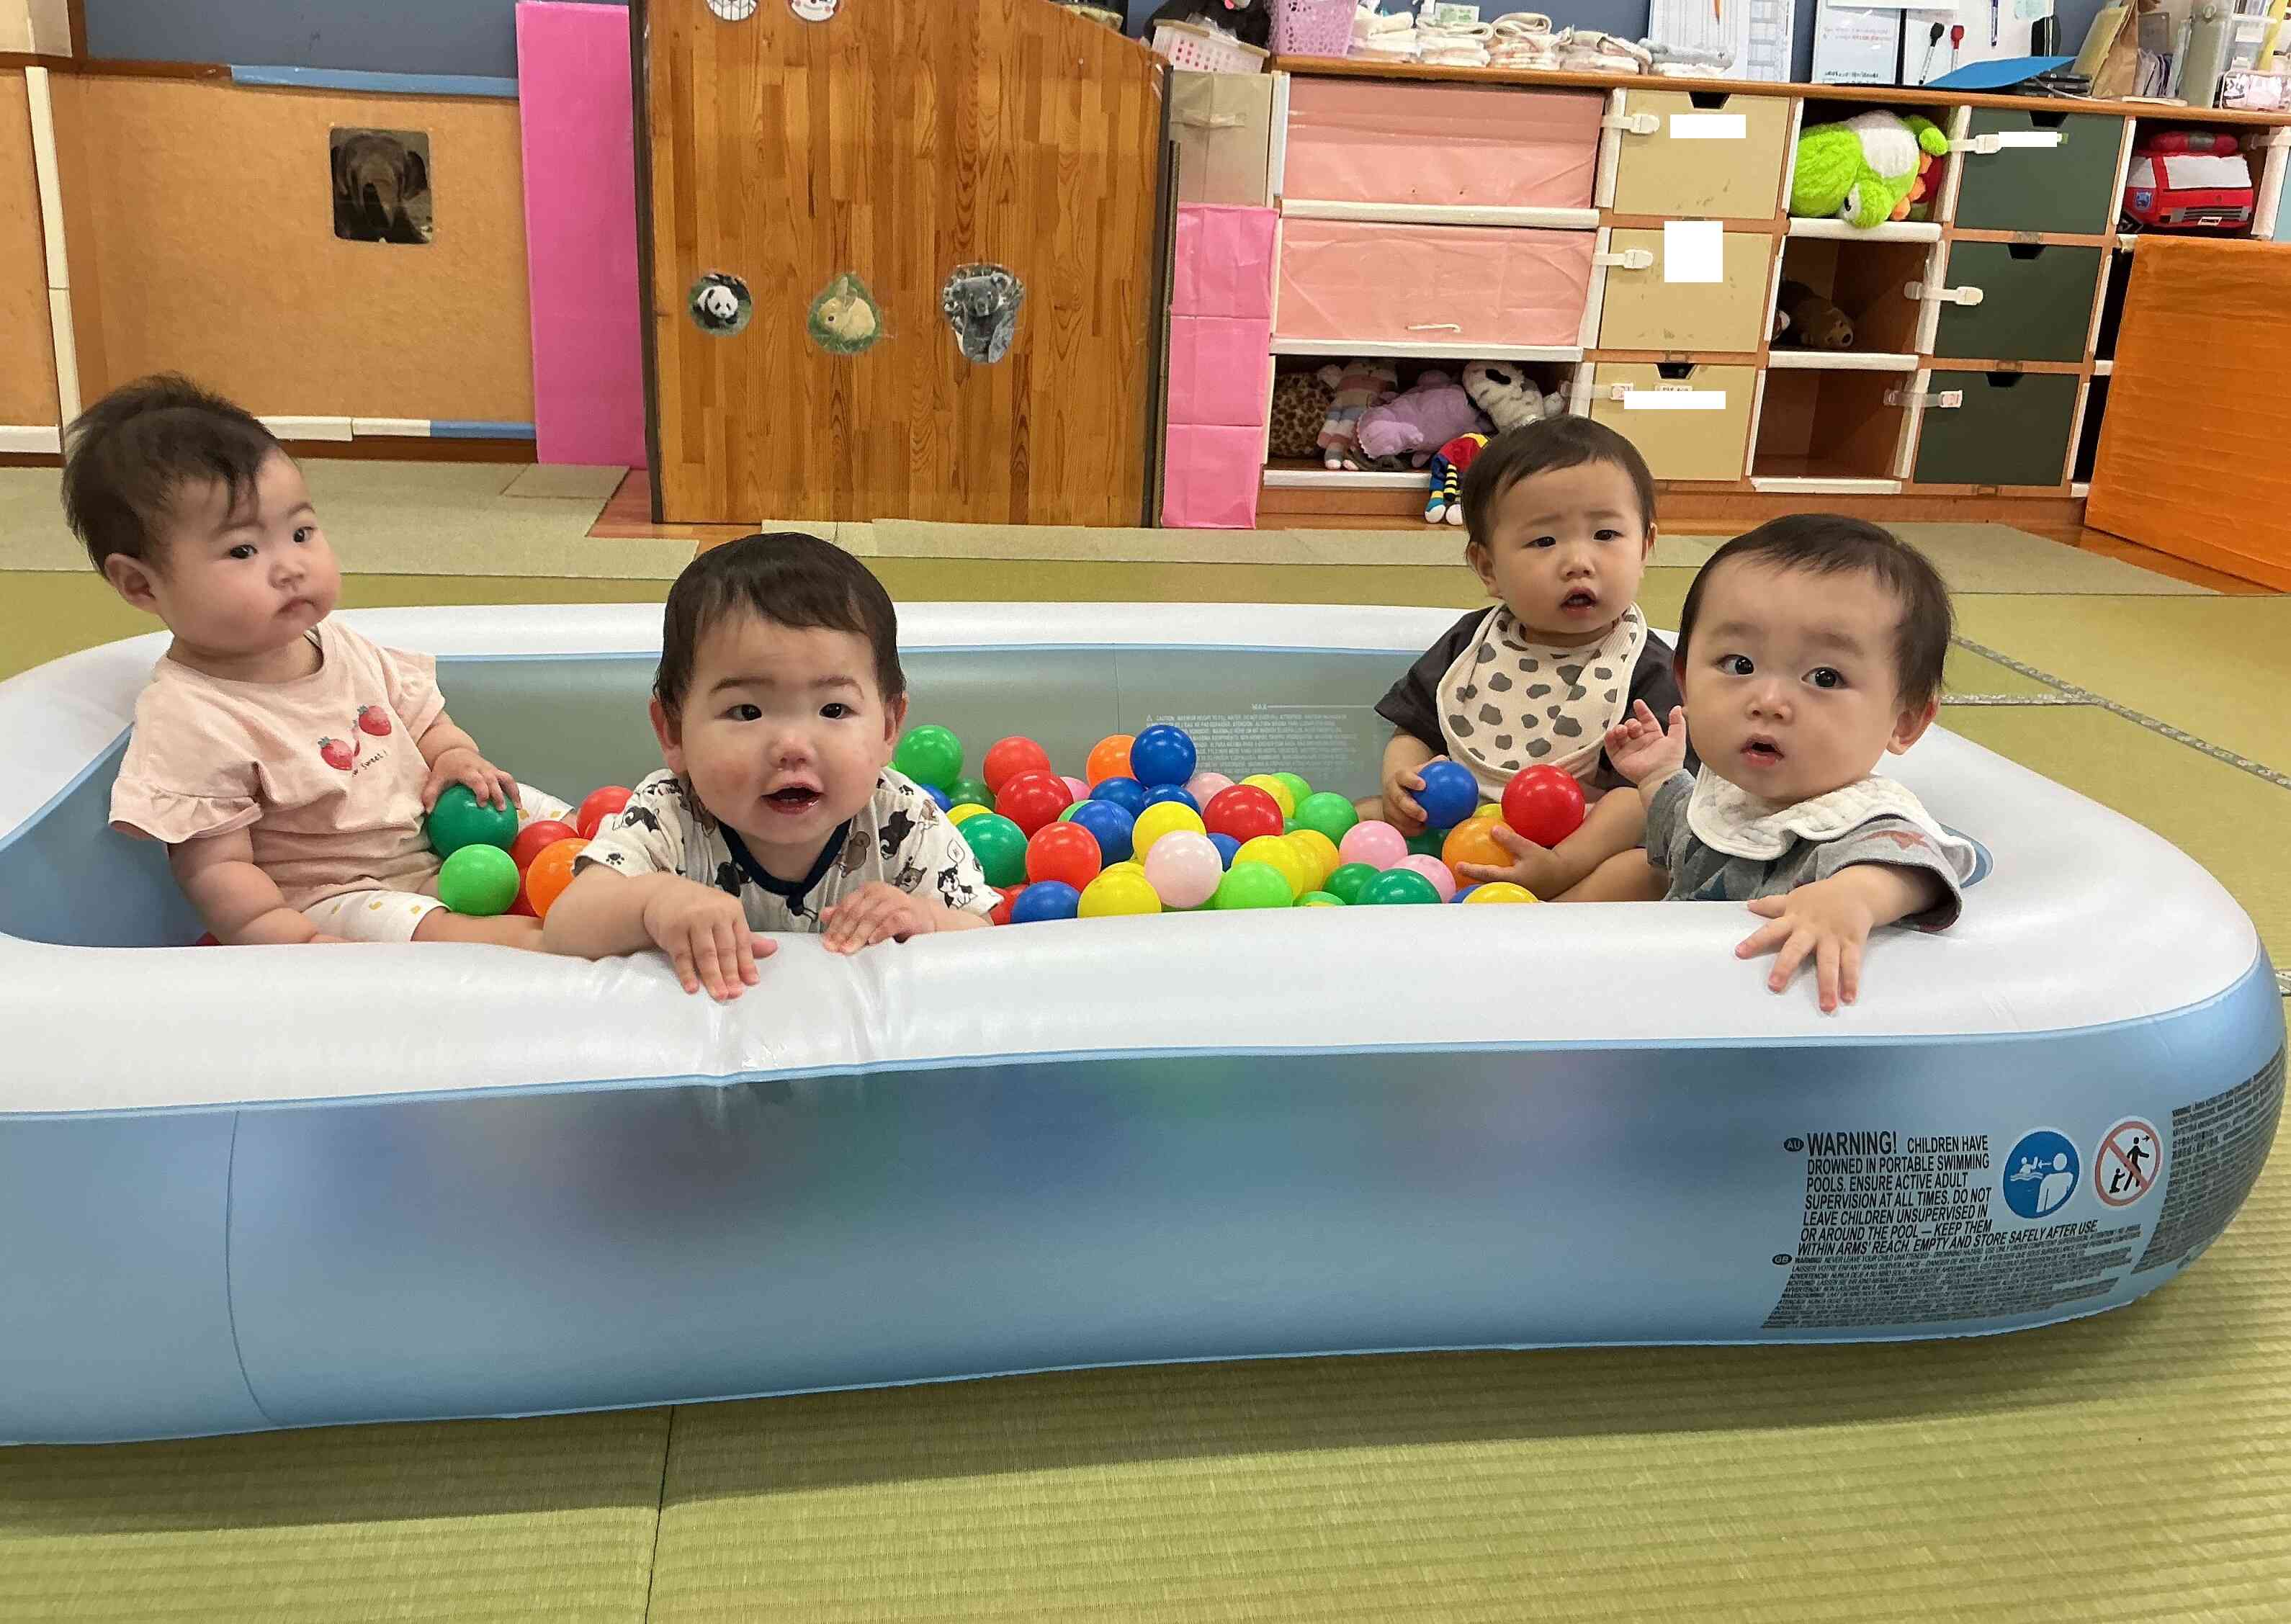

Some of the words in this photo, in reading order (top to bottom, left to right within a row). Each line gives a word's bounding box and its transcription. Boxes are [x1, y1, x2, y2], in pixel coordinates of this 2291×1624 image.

[1785, 1139, 1802, 1150] AU
[1807, 1131, 1897, 1156] WARNING!
[1907, 1136, 1959, 1153] CHILDREN
[1961, 1135, 1988, 1152] HAVE
[1808, 1157, 1862, 1175] DROWNED
[1866, 1157, 1876, 1173] IN
[1879, 1155, 1934, 1173] PORTABLE
[1937, 1153, 1989, 1171] SWIMMING
[1806, 1176, 1846, 1193] POOLS.
[1849, 1175, 1893, 1192] ENSURE
[1895, 1173, 1932, 1190] ACTIVE
[1934, 1172, 1968, 1188] ADULT
[1805, 1193, 1877, 1210] SUPERVISION
[1878, 1192, 1893, 1208] AT
[1894, 1192, 1914, 1207] ALL
[1917, 1190, 1950, 1206] TIMES.
[1953, 1189, 1968, 1204] DO
[1970, 1187, 1992, 1203] NOT
[1803, 1211, 1839, 1226] LEAVE
[1840, 1210, 1895, 1226] CHILDREN
[1896, 1205, 1975, 1224] UNSUPERVISED
[1977, 1203, 1989, 1218] IN
[1798, 1242, 1835, 1256] WITHIN
[1835, 1241, 1872, 1255] ARMS'
[1913, 1237, 1950, 1252] EMPTY
[1949, 1235, 1972, 1250] AND
[1973, 1232, 2008, 1247] STORE
[2009, 1226, 2047, 1244] SAFELY
[2045, 1224, 2078, 1239] AFTER
[1801, 1227, 1817, 1242] OR
[1818, 1226, 1865, 1241] AROUND
[1868, 1226, 1889, 1239] THE
[1890, 1224, 1918, 1239] POOL
[1934, 1222, 1963, 1237] KEEP
[1964, 1219, 1993, 1234] THEM
